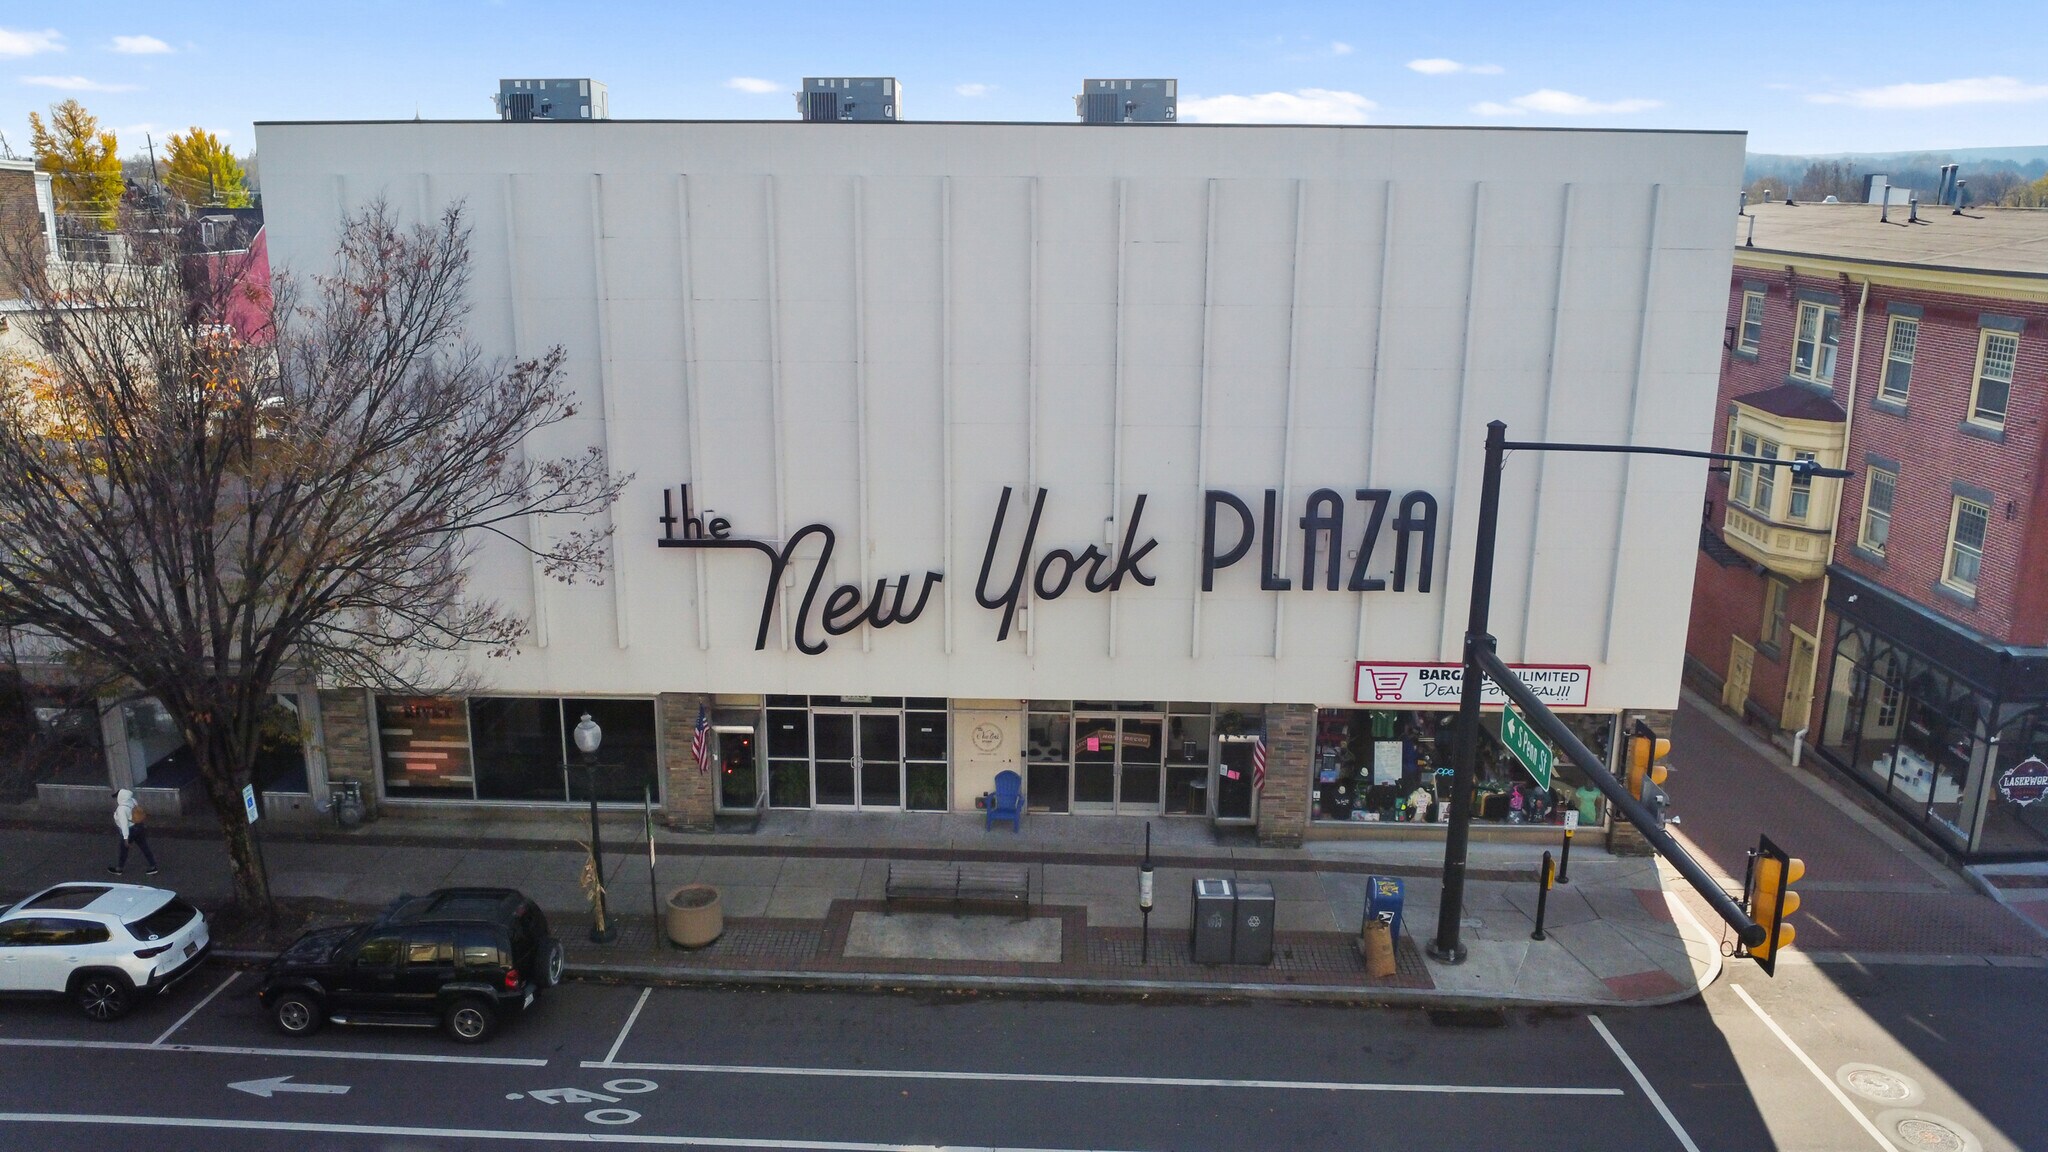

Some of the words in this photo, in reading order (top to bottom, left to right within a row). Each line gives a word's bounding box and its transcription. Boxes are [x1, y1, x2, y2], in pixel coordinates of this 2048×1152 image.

[659, 484, 731, 540] the
[754, 523, 944, 656] New
[975, 485, 1159, 642] York
[1201, 487, 1429, 593] PLAZA
[1418, 669, 1497, 682] BARGN
[1511, 671, 1580, 683] NLIMITED
[1423, 682, 1462, 698] DEAL
[1517, 725, 1524, 748] S
[1522, 730, 1538, 766] Penn
[1538, 749, 1547, 776] St
[1437, 767, 1454, 776] ope
